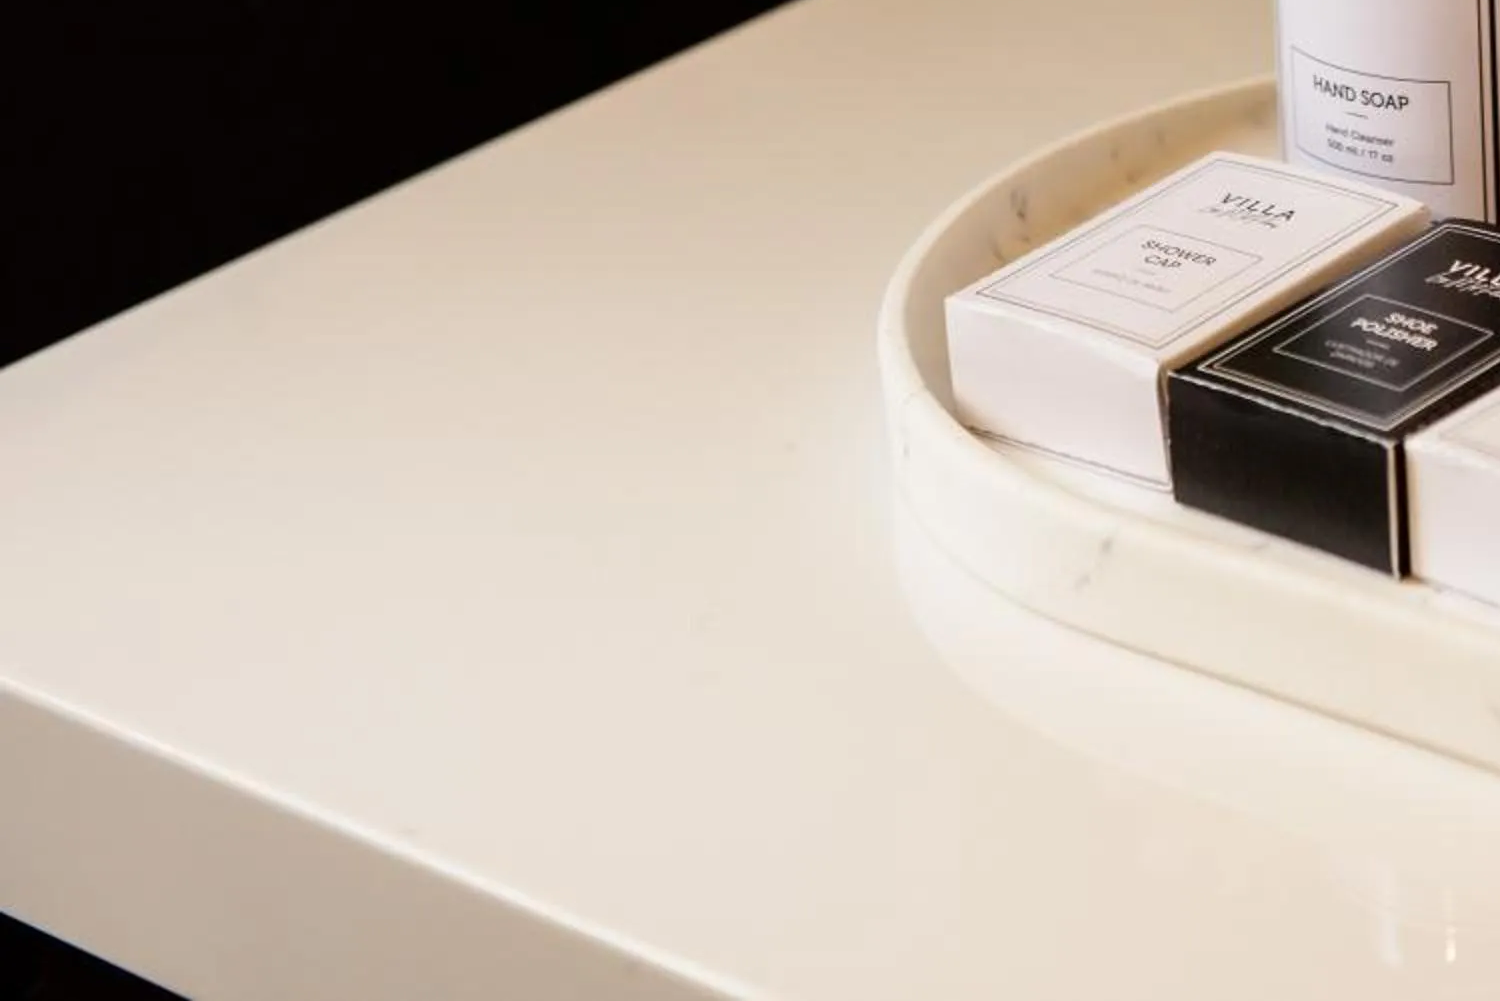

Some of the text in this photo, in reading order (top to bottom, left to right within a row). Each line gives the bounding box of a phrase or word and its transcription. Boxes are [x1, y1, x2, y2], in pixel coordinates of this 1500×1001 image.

[1312, 75, 1410, 111] HAND SOAP
[1325, 123, 1395, 147] Hand Cleanser
[1327, 138, 1345, 152] 500
[1368, 150, 1379, 159] 17
[1220, 192, 1296, 222] VILLA
[1141, 239, 1217, 267] SHOWER
[1144, 255, 1182, 269] CAP
[1350, 317, 1439, 352] POLISHER
[1384, 311, 1439, 335] SHOE
